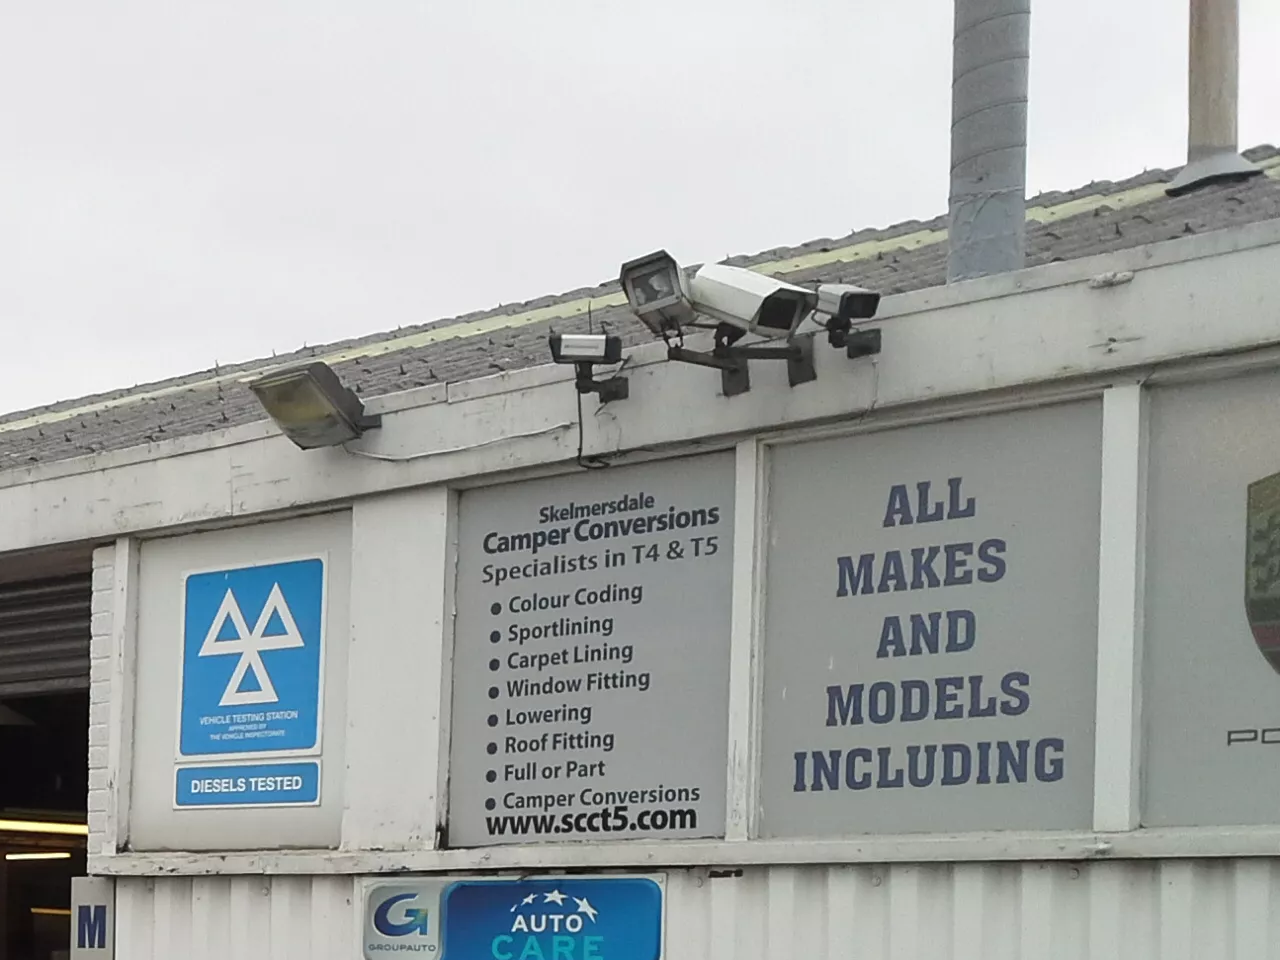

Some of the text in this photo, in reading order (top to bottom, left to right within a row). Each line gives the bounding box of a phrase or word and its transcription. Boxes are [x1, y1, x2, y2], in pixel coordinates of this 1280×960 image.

[539, 492, 655, 524] Skelmersdale
[882, 477, 976, 528] ALL
[483, 506, 720, 554] Camper Conversions
[482, 536, 719, 586] Specialists in T4 & T5
[835, 538, 1008, 598] MAKES
[508, 584, 643, 614] Colour Coding
[508, 616, 614, 645] Sportlining
[876, 608, 977, 659] AND
[507, 644, 634, 671] Carpet Lining
[506, 671, 650, 698] Window Fitting
[825, 672, 1031, 727] MODELS
[200, 710, 298, 725] VEHICLE TESTING STATION
[505, 704, 592, 725] Lowering
[505, 731, 614, 753] Roof Fitting
[504, 760, 605, 781] Full or Part
[793, 737, 1065, 792] INCLUDING
[191, 776, 302, 793] DIESELS TESTED
[503, 785, 700, 812] Camper Conversions
[486, 805, 697, 835] www.scct5.com
[511, 914, 583, 933] AUTO
[368, 943, 436, 952] GROUPAUTO
